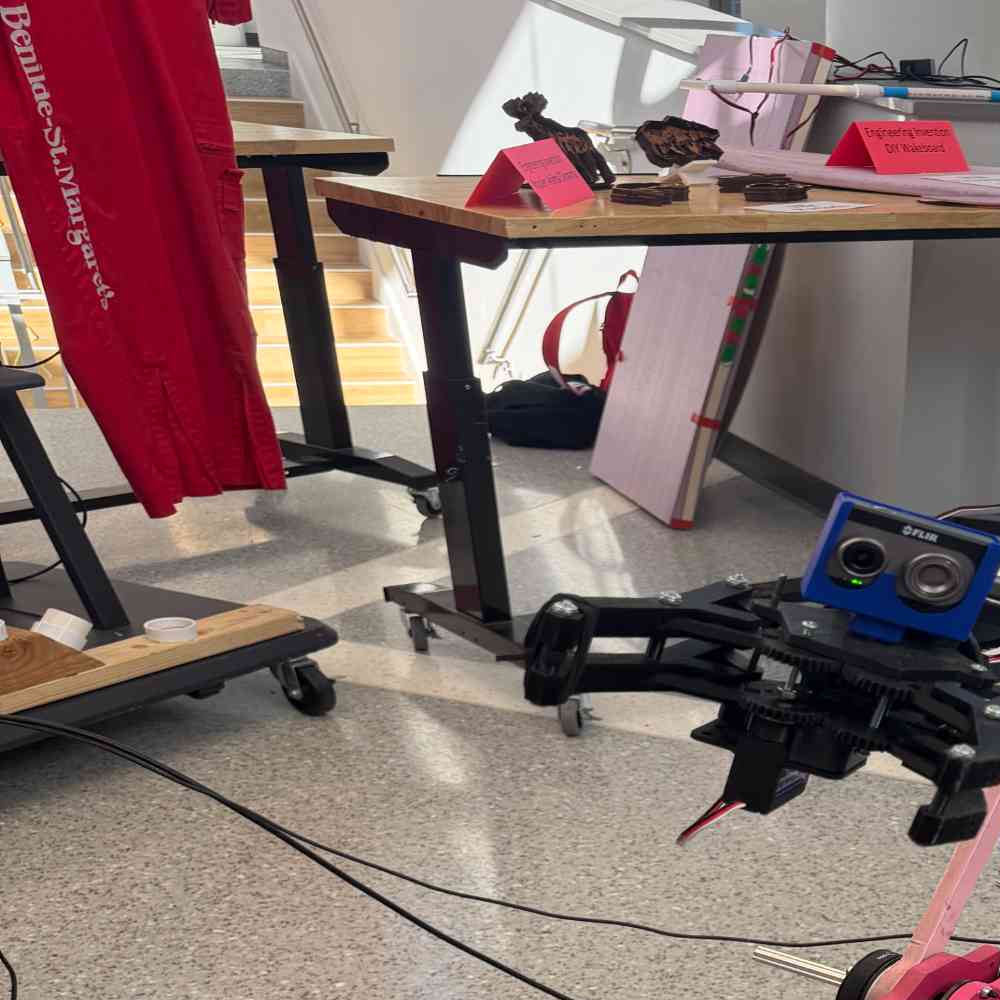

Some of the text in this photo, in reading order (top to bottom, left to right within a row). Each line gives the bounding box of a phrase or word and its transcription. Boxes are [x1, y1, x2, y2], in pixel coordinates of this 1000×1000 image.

[864, 127, 951, 139] Engineering Invention
[885, 143, 946, 154] DIY Wakeboard
[911, 528, 939, 542] FLIR
